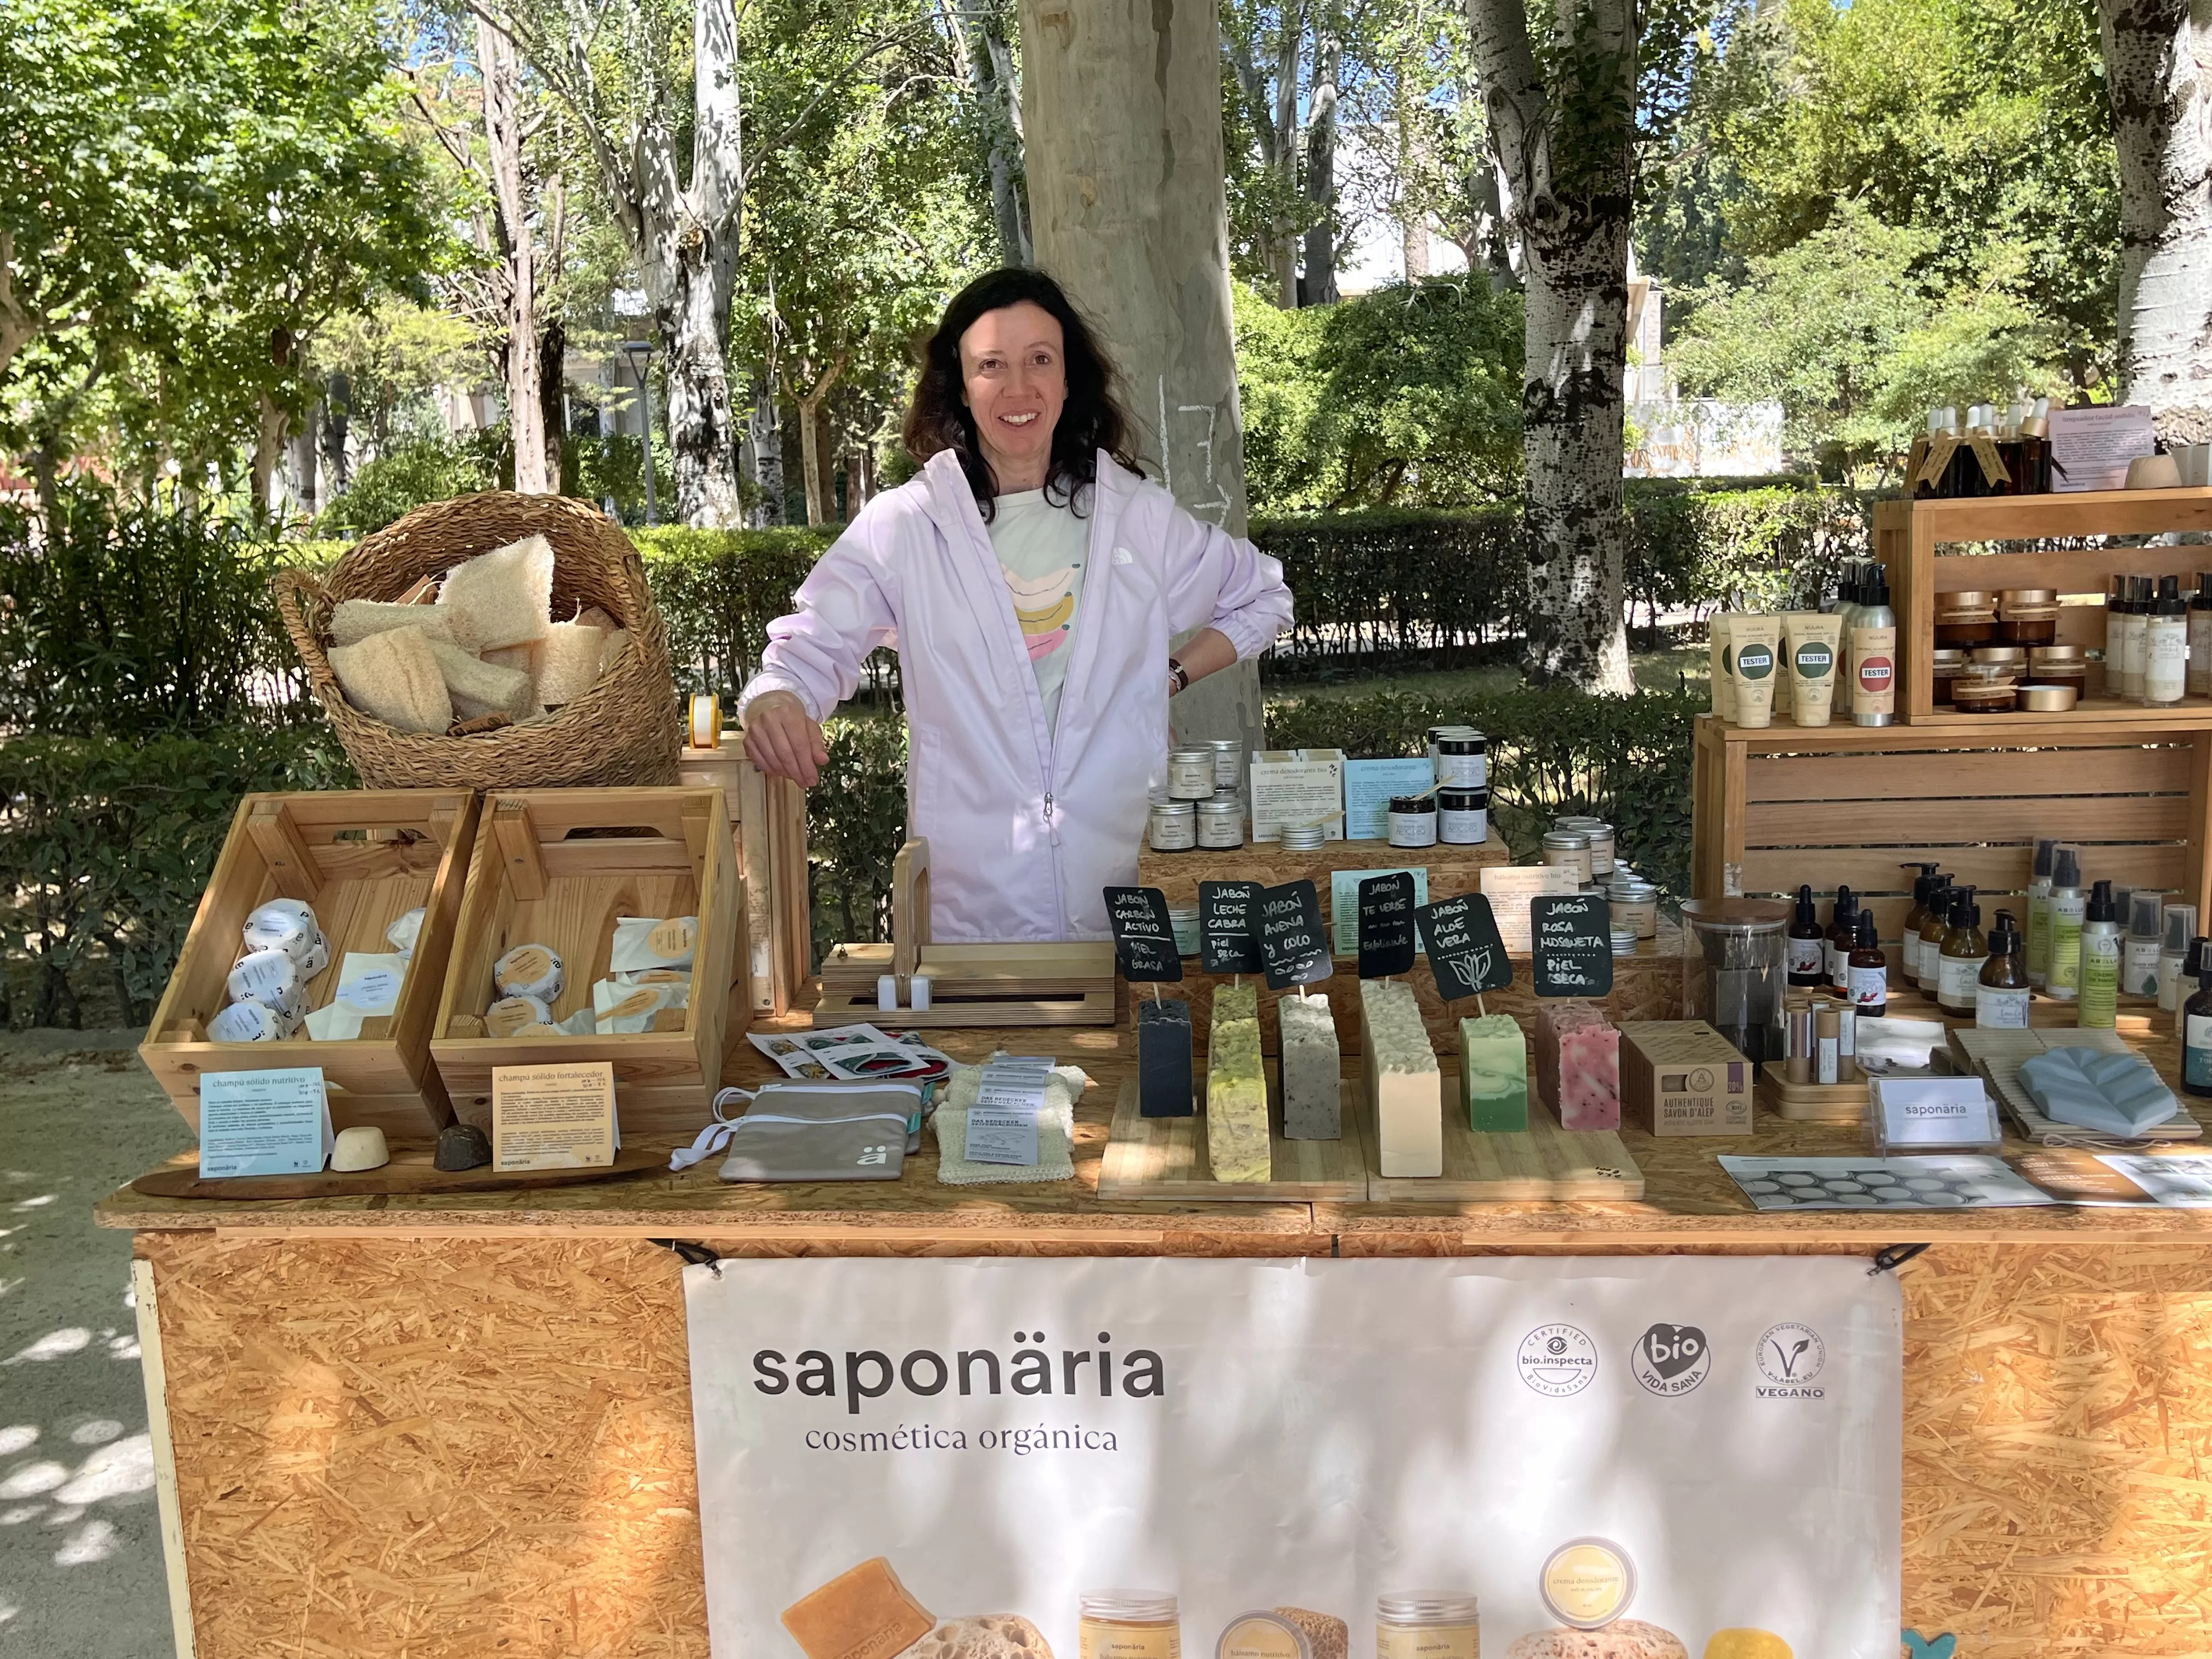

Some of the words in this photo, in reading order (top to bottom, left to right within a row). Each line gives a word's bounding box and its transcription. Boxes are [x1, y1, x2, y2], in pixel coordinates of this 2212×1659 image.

[1743, 657, 1767, 665] TESTER
[1214, 903, 1247, 915] LECHE
[1362, 905, 1375, 916] TE
[1379, 898, 1407, 912] VERDE
[1208, 918, 1246, 928] CABRA
[1265, 915, 1304, 936] AVENA
[1434, 916, 1465, 936] ALOE
[1542, 921, 1573, 933] ROSA
[1284, 935, 1310, 950] COCO
[1436, 933, 1471, 949] VERA
[1540, 936, 1604, 949] MOSQUETA
[1132, 959, 1163, 972] GRASA
[1551, 973, 1585, 985] SECA
[213, 1079, 244, 1087] champú
[272, 1076, 305, 1085] nutritivo
[499, 1074, 530, 1082] champú
[557, 1070, 603, 1079] fortalecedor
[1728, 1081, 1743, 1092] 20%
[1664, 1097, 1714, 1108] AUTHENTIQUE
[1664, 1108, 1687, 1118] SAVON
[1690, 1107, 1714, 1118] D'ALEP
[1905, 1104, 1967, 1116] saponäria
[857, 1146, 886, 1165] ä
[1528, 1328, 1587, 1346] CERTIFIED
[1651, 1333, 1699, 1363] bio
[1758, 1330, 1775, 1367] EUROPEAN
[1775, 1324, 1819, 1343] VEGETARIAN
[1522, 1355, 1593, 1367] bio.inspecta
[753, 1331, 1164, 1414] saponäria
[1768, 1371, 1813, 1384] V-LABEL.EU
[1643, 1370, 1667, 1392] VIDA
[1671, 1371, 1702, 1392] SANA
[1757, 1387, 1824, 1398] VEGANO
[805, 1424, 968, 1452] cosmética
[979, 1423, 1118, 1455] orgánica
[1416, 1644, 1450, 1652] saponäria
